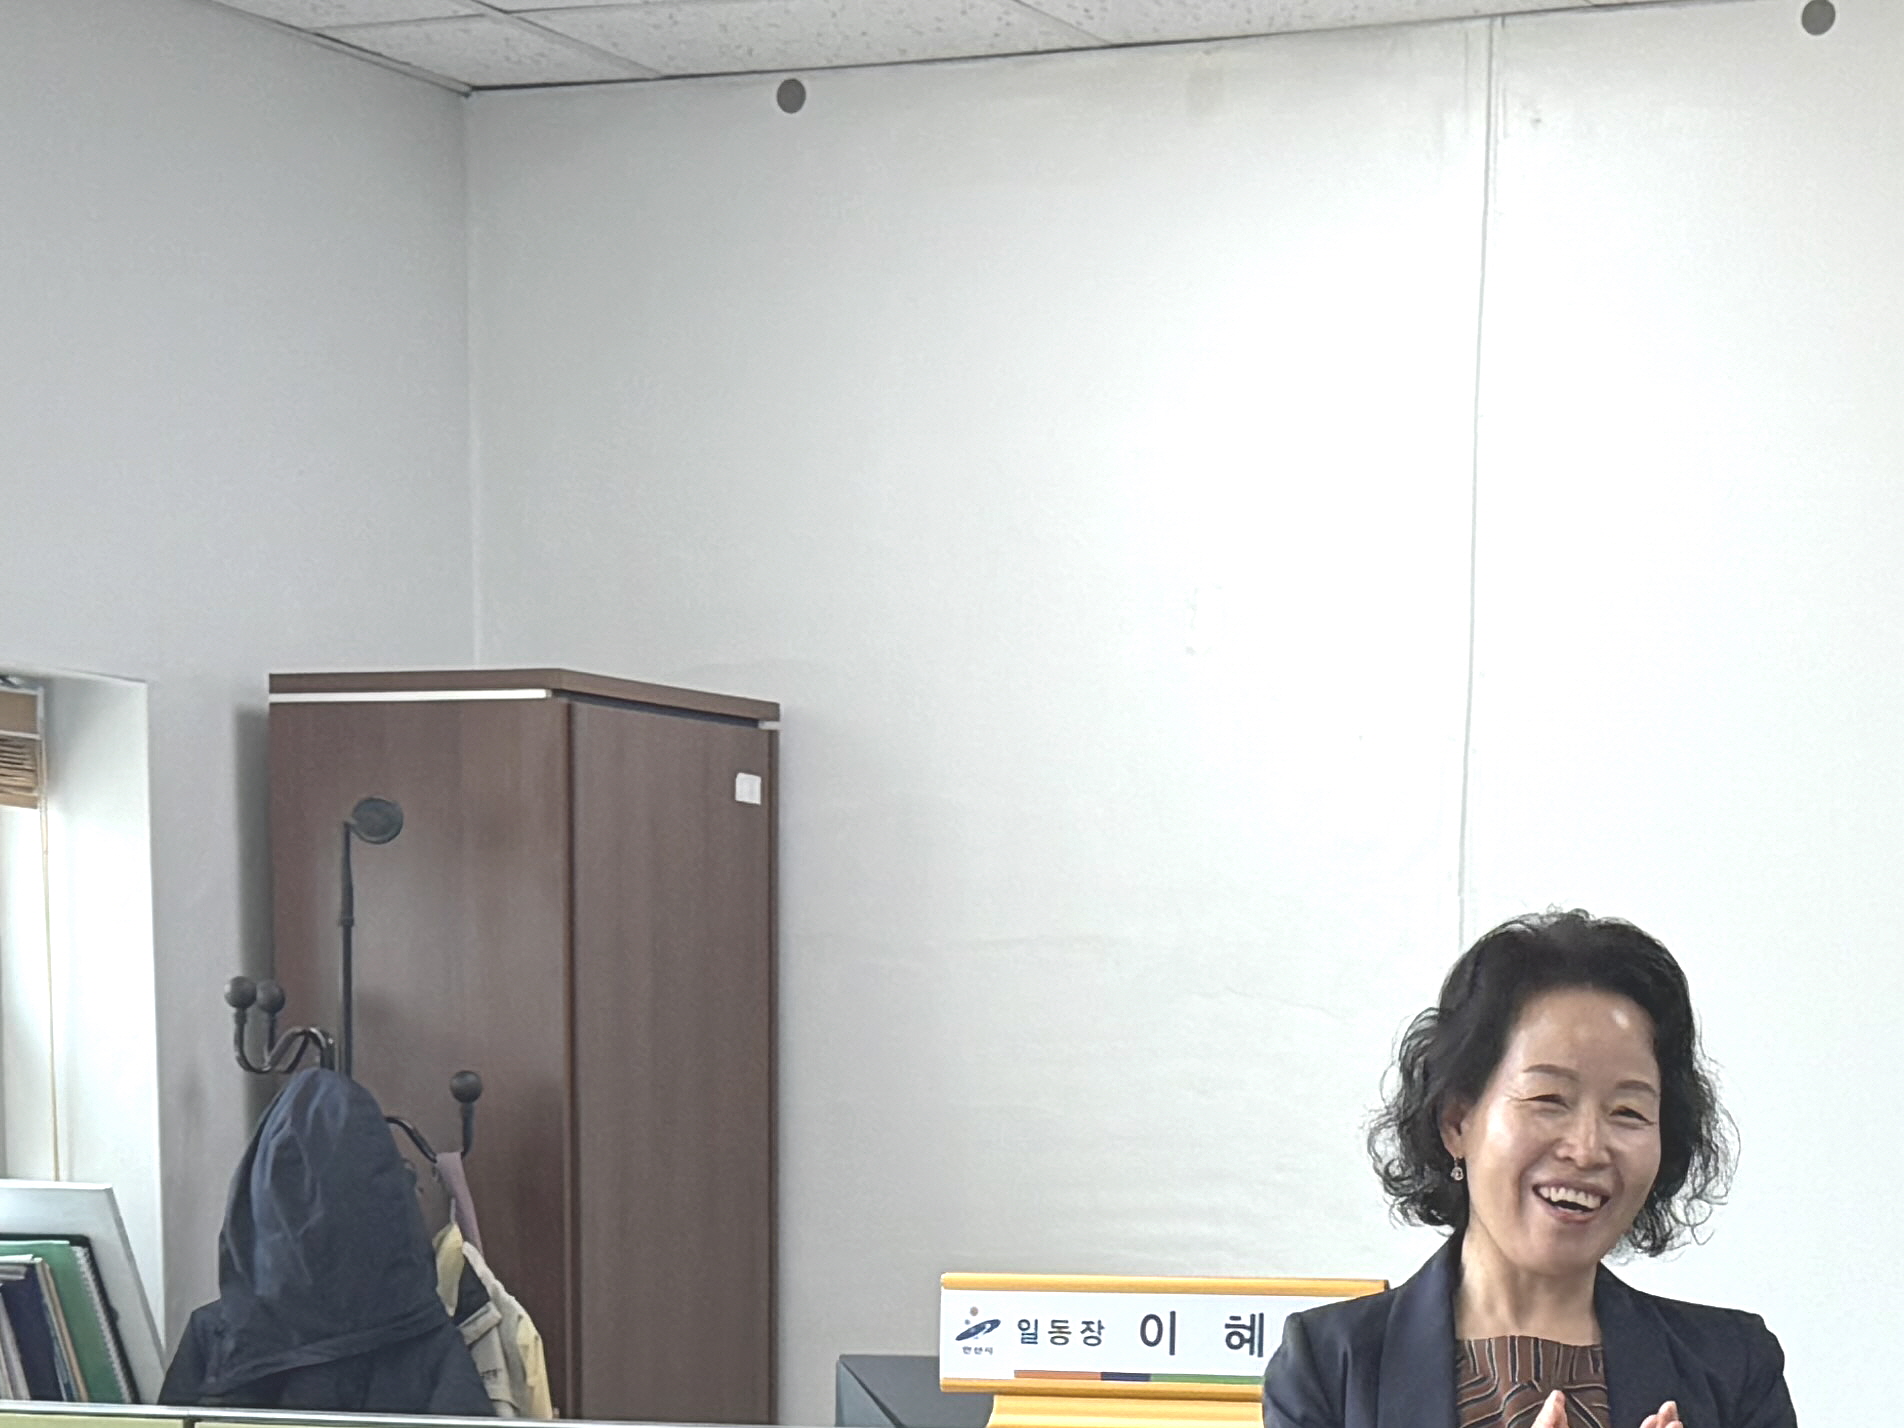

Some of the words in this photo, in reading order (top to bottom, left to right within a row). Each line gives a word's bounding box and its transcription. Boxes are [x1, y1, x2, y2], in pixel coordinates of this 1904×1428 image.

[1017, 1318, 1105, 1347] 일동장
[1139, 1310, 1177, 1357] 이
[1224, 1312, 1265, 1358] 혜
